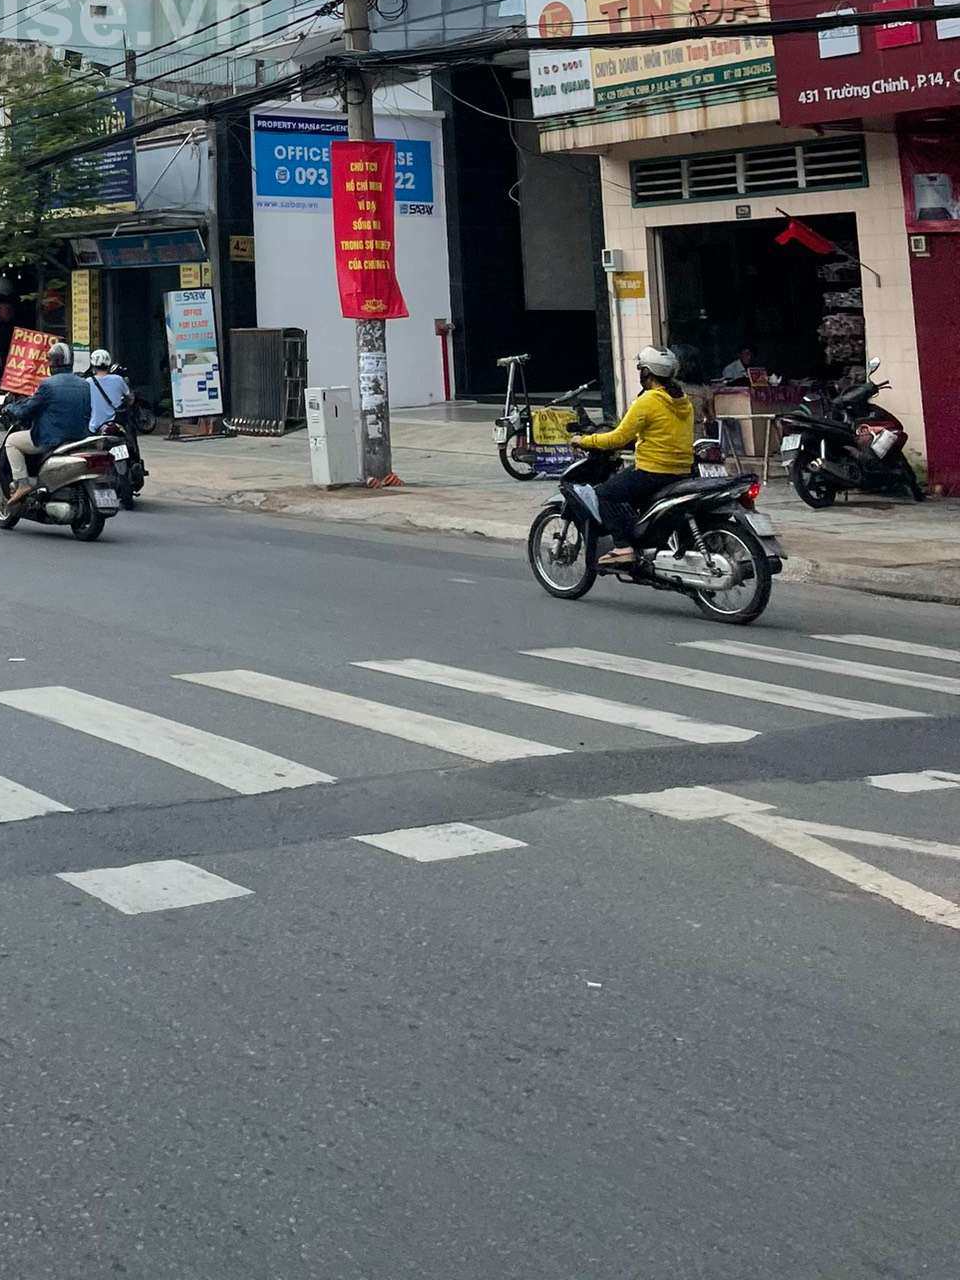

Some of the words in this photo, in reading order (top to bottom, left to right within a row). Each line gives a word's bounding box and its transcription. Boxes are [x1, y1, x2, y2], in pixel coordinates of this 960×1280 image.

[798, 89, 819, 104] 431
[823, 83, 870, 100] Trường
[257, 119, 297, 130] PROPERTY
[274, 145, 330, 162] OFFICE
[294, 167, 329, 186] 093
[409, 203, 434, 216] SABAY
[14, 329, 59, 346] PHOTO
[10, 344, 26, 358] IN
